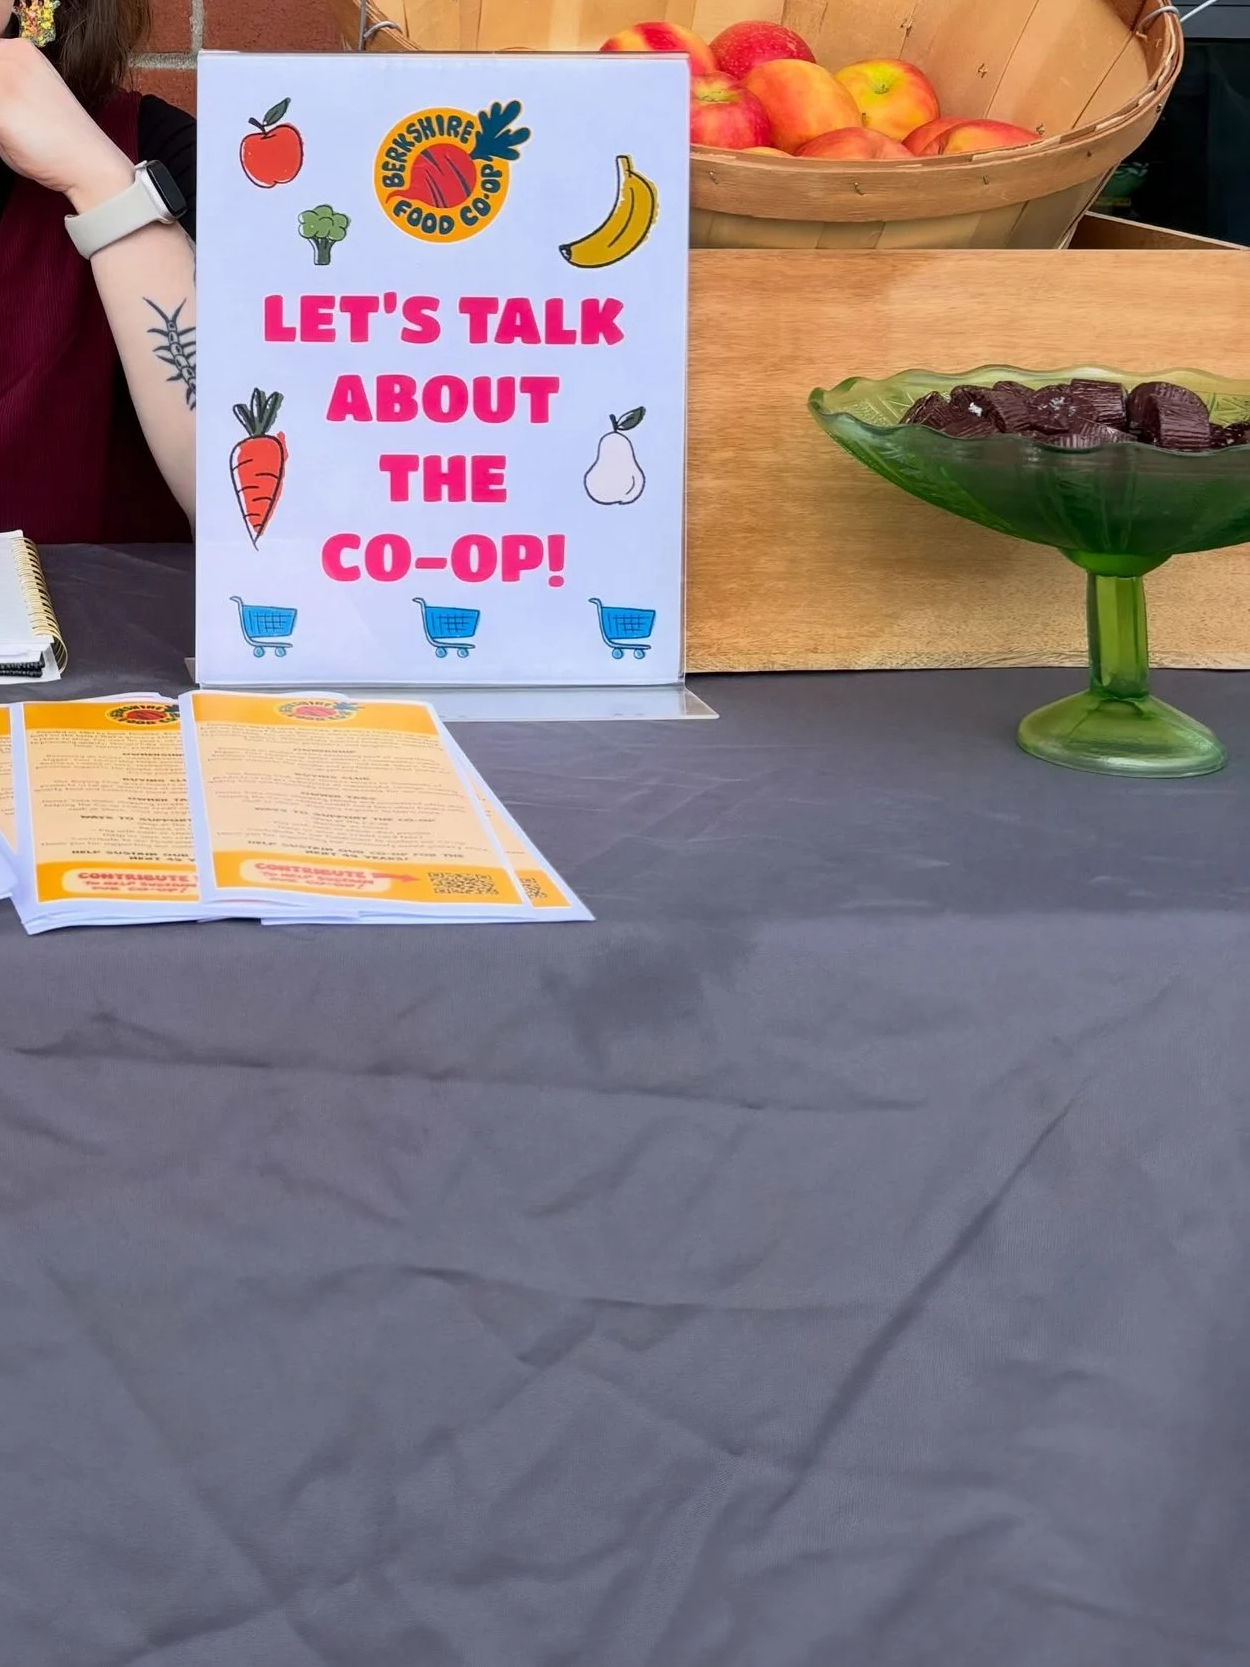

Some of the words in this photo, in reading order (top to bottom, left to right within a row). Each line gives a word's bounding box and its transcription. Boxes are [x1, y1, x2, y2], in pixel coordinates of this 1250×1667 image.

[382, 114, 475, 188] BERKSHIRE
[393, 200, 454, 235] FOOD
[460, 164, 502, 226] CO-OP
[264, 291, 440, 346] LET'S
[458, 297, 625, 346] TALK
[326, 375, 559, 424] ABOUT
[378, 454, 507, 502] THE
[321, 533, 565, 587] CO-OP!
[78, 872, 190, 882] CONTRIBUTE
[254, 862, 366, 879] CONTRIBUTE
